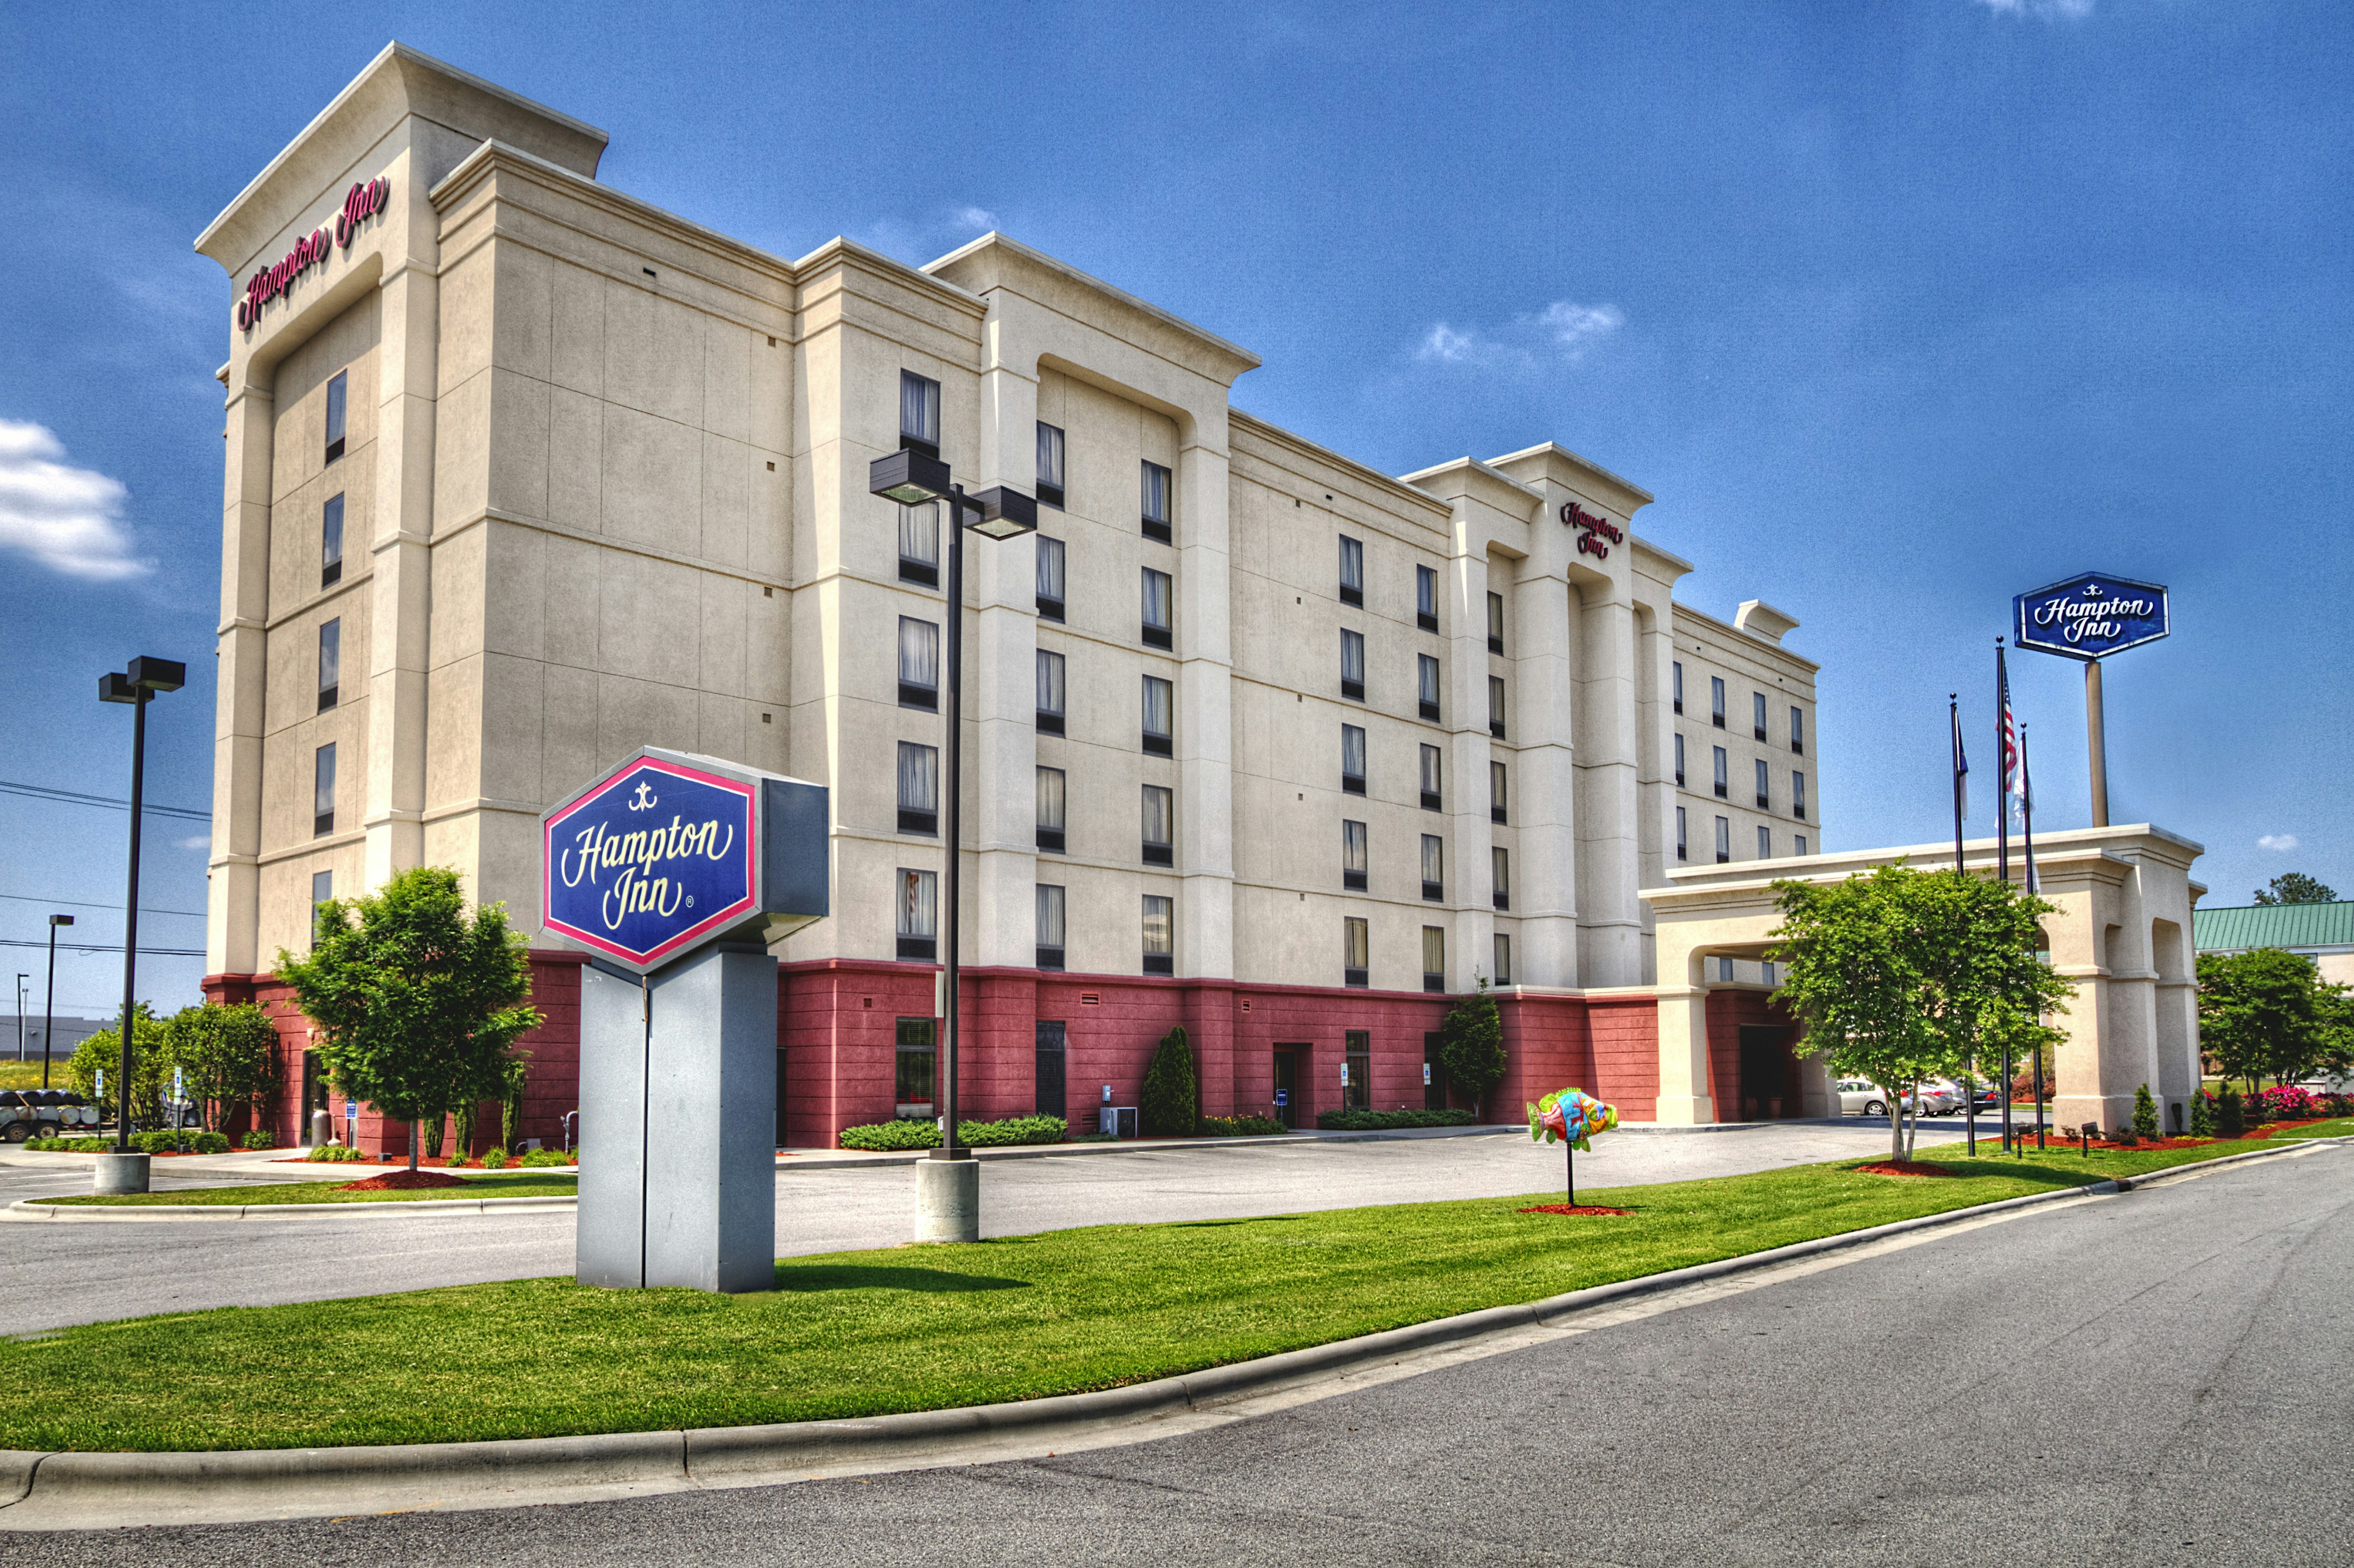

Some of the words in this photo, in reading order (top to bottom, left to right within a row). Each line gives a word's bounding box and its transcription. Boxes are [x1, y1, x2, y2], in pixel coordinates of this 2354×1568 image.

[238, 227, 332, 332] Hampton
[336, 176, 390, 249] Inn
[1560, 502, 1623, 544] Hampton
[1577, 531, 1608, 559] Inn
[2035, 597, 2153, 624] Hampton
[2064, 617, 2121, 643] Inn
[561, 815, 733, 887] Hampton
[602, 867, 682, 930] Inn
